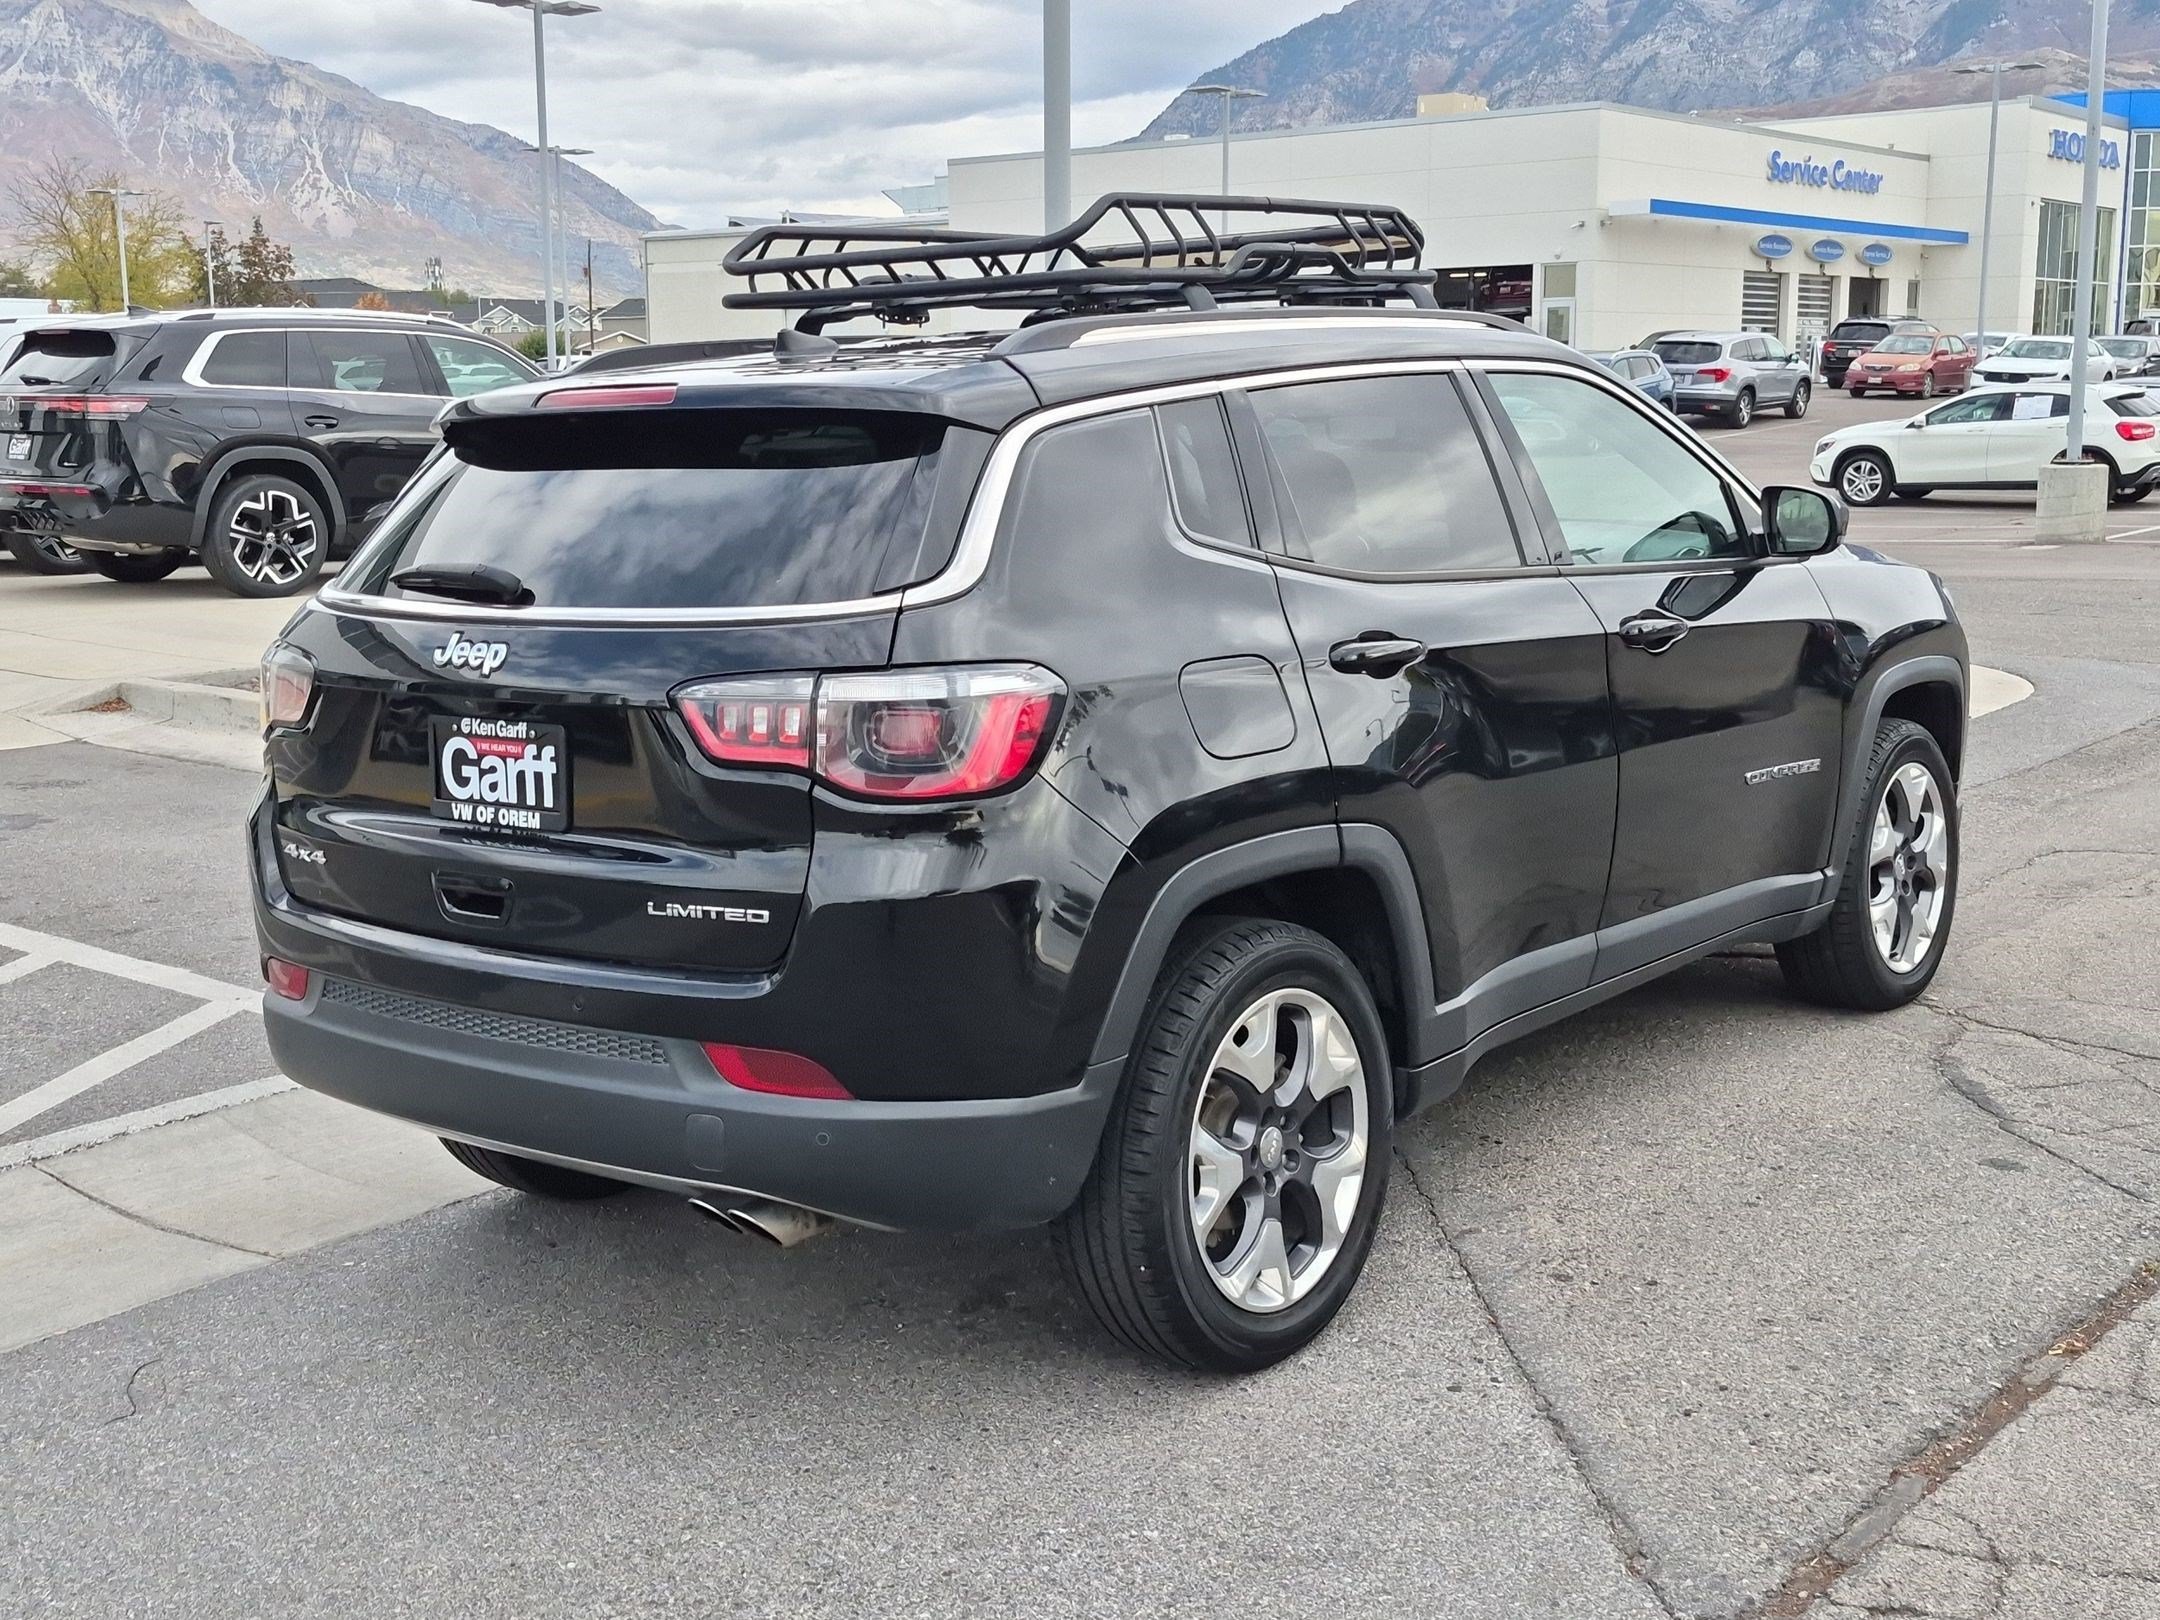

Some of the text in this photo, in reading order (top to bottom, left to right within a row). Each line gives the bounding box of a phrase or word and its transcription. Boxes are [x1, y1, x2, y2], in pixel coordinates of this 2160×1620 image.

[1767, 150, 1883, 194] Service Center
[433, 631, 509, 678] Jeep
[472, 718, 496, 737] Ken
[497, 720, 528, 739] Garff
[442, 736, 557, 808] Garff
[451, 802, 541, 830] VW OF OREM
[647, 901, 770, 924] LIMITED
